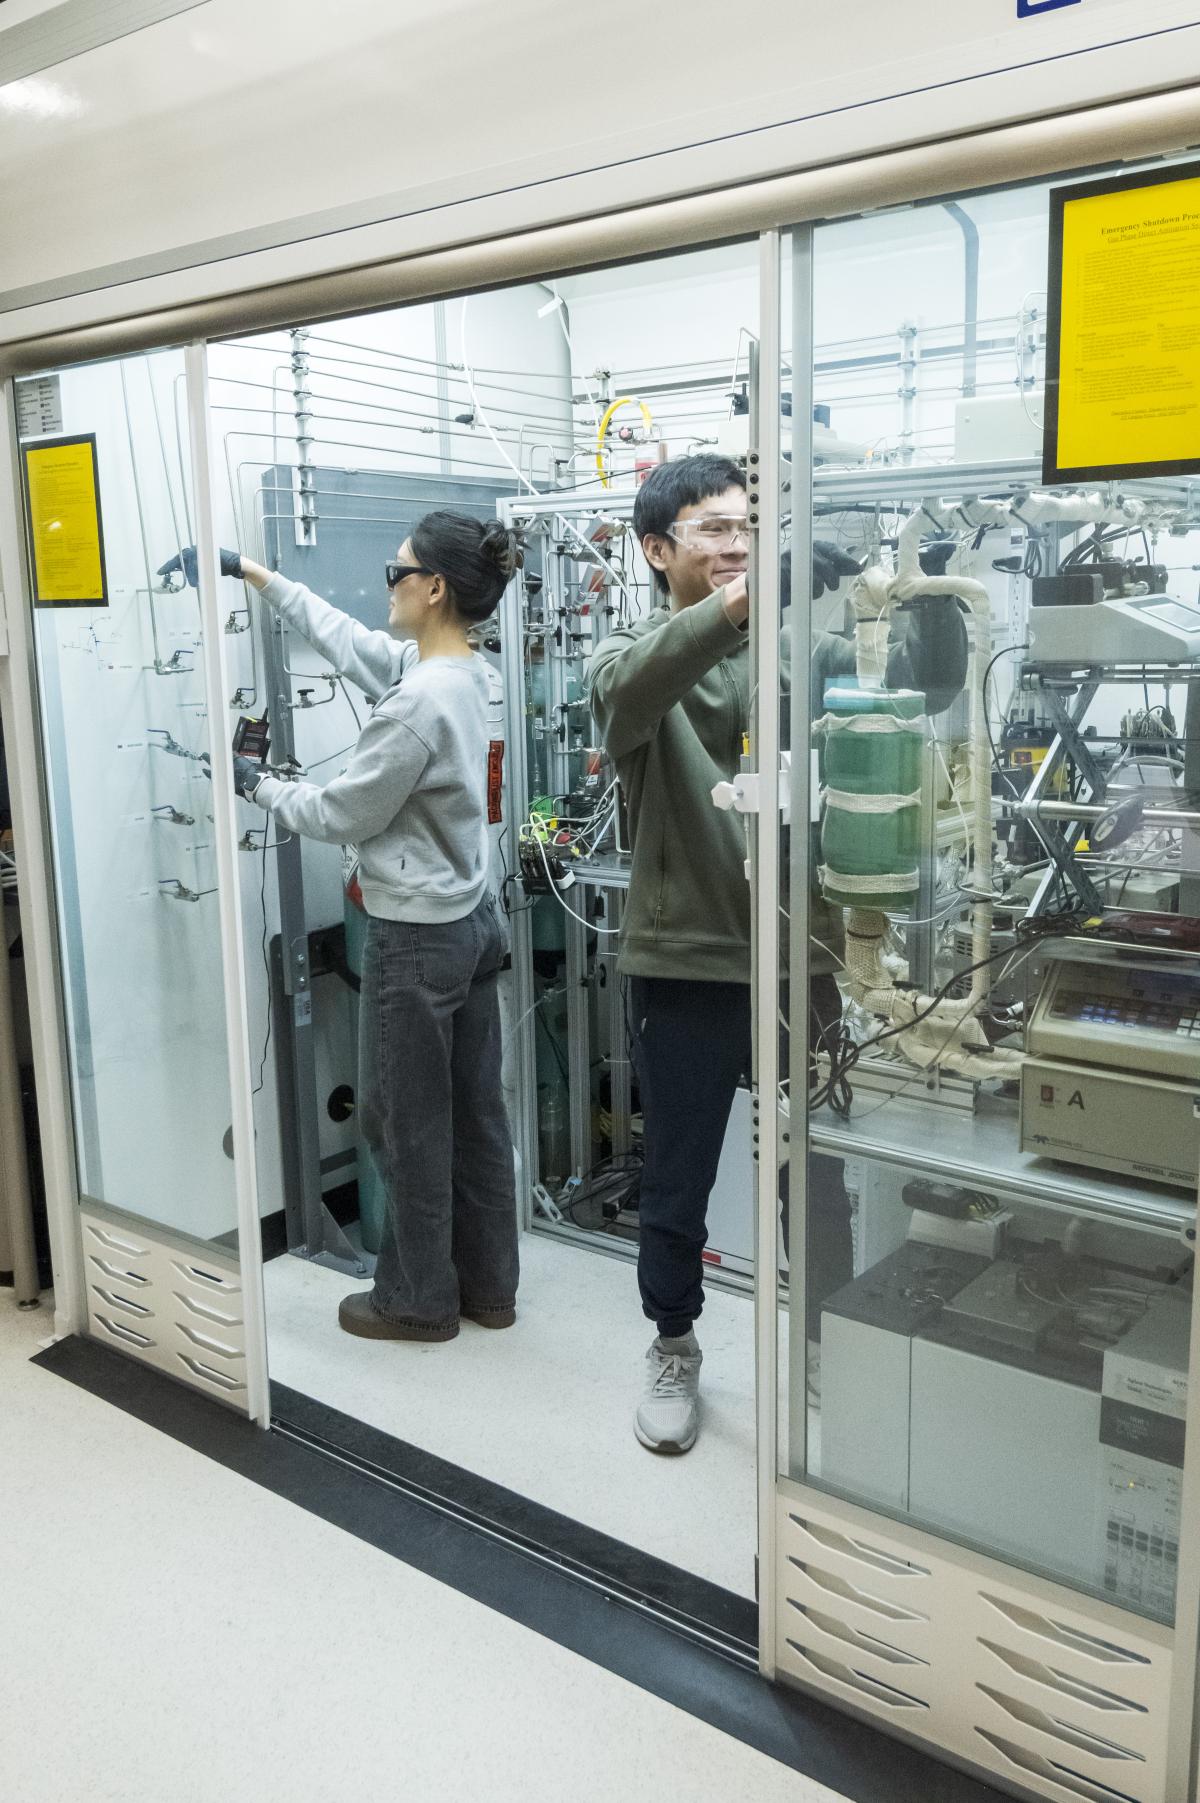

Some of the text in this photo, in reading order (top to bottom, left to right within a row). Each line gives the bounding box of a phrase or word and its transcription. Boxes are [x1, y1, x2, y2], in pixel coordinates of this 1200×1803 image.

[1101, 223, 1140, 236] Emergency
[1143, 217, 1180, 228] Shutdown
[1067, 1090, 1085, 1110] A
